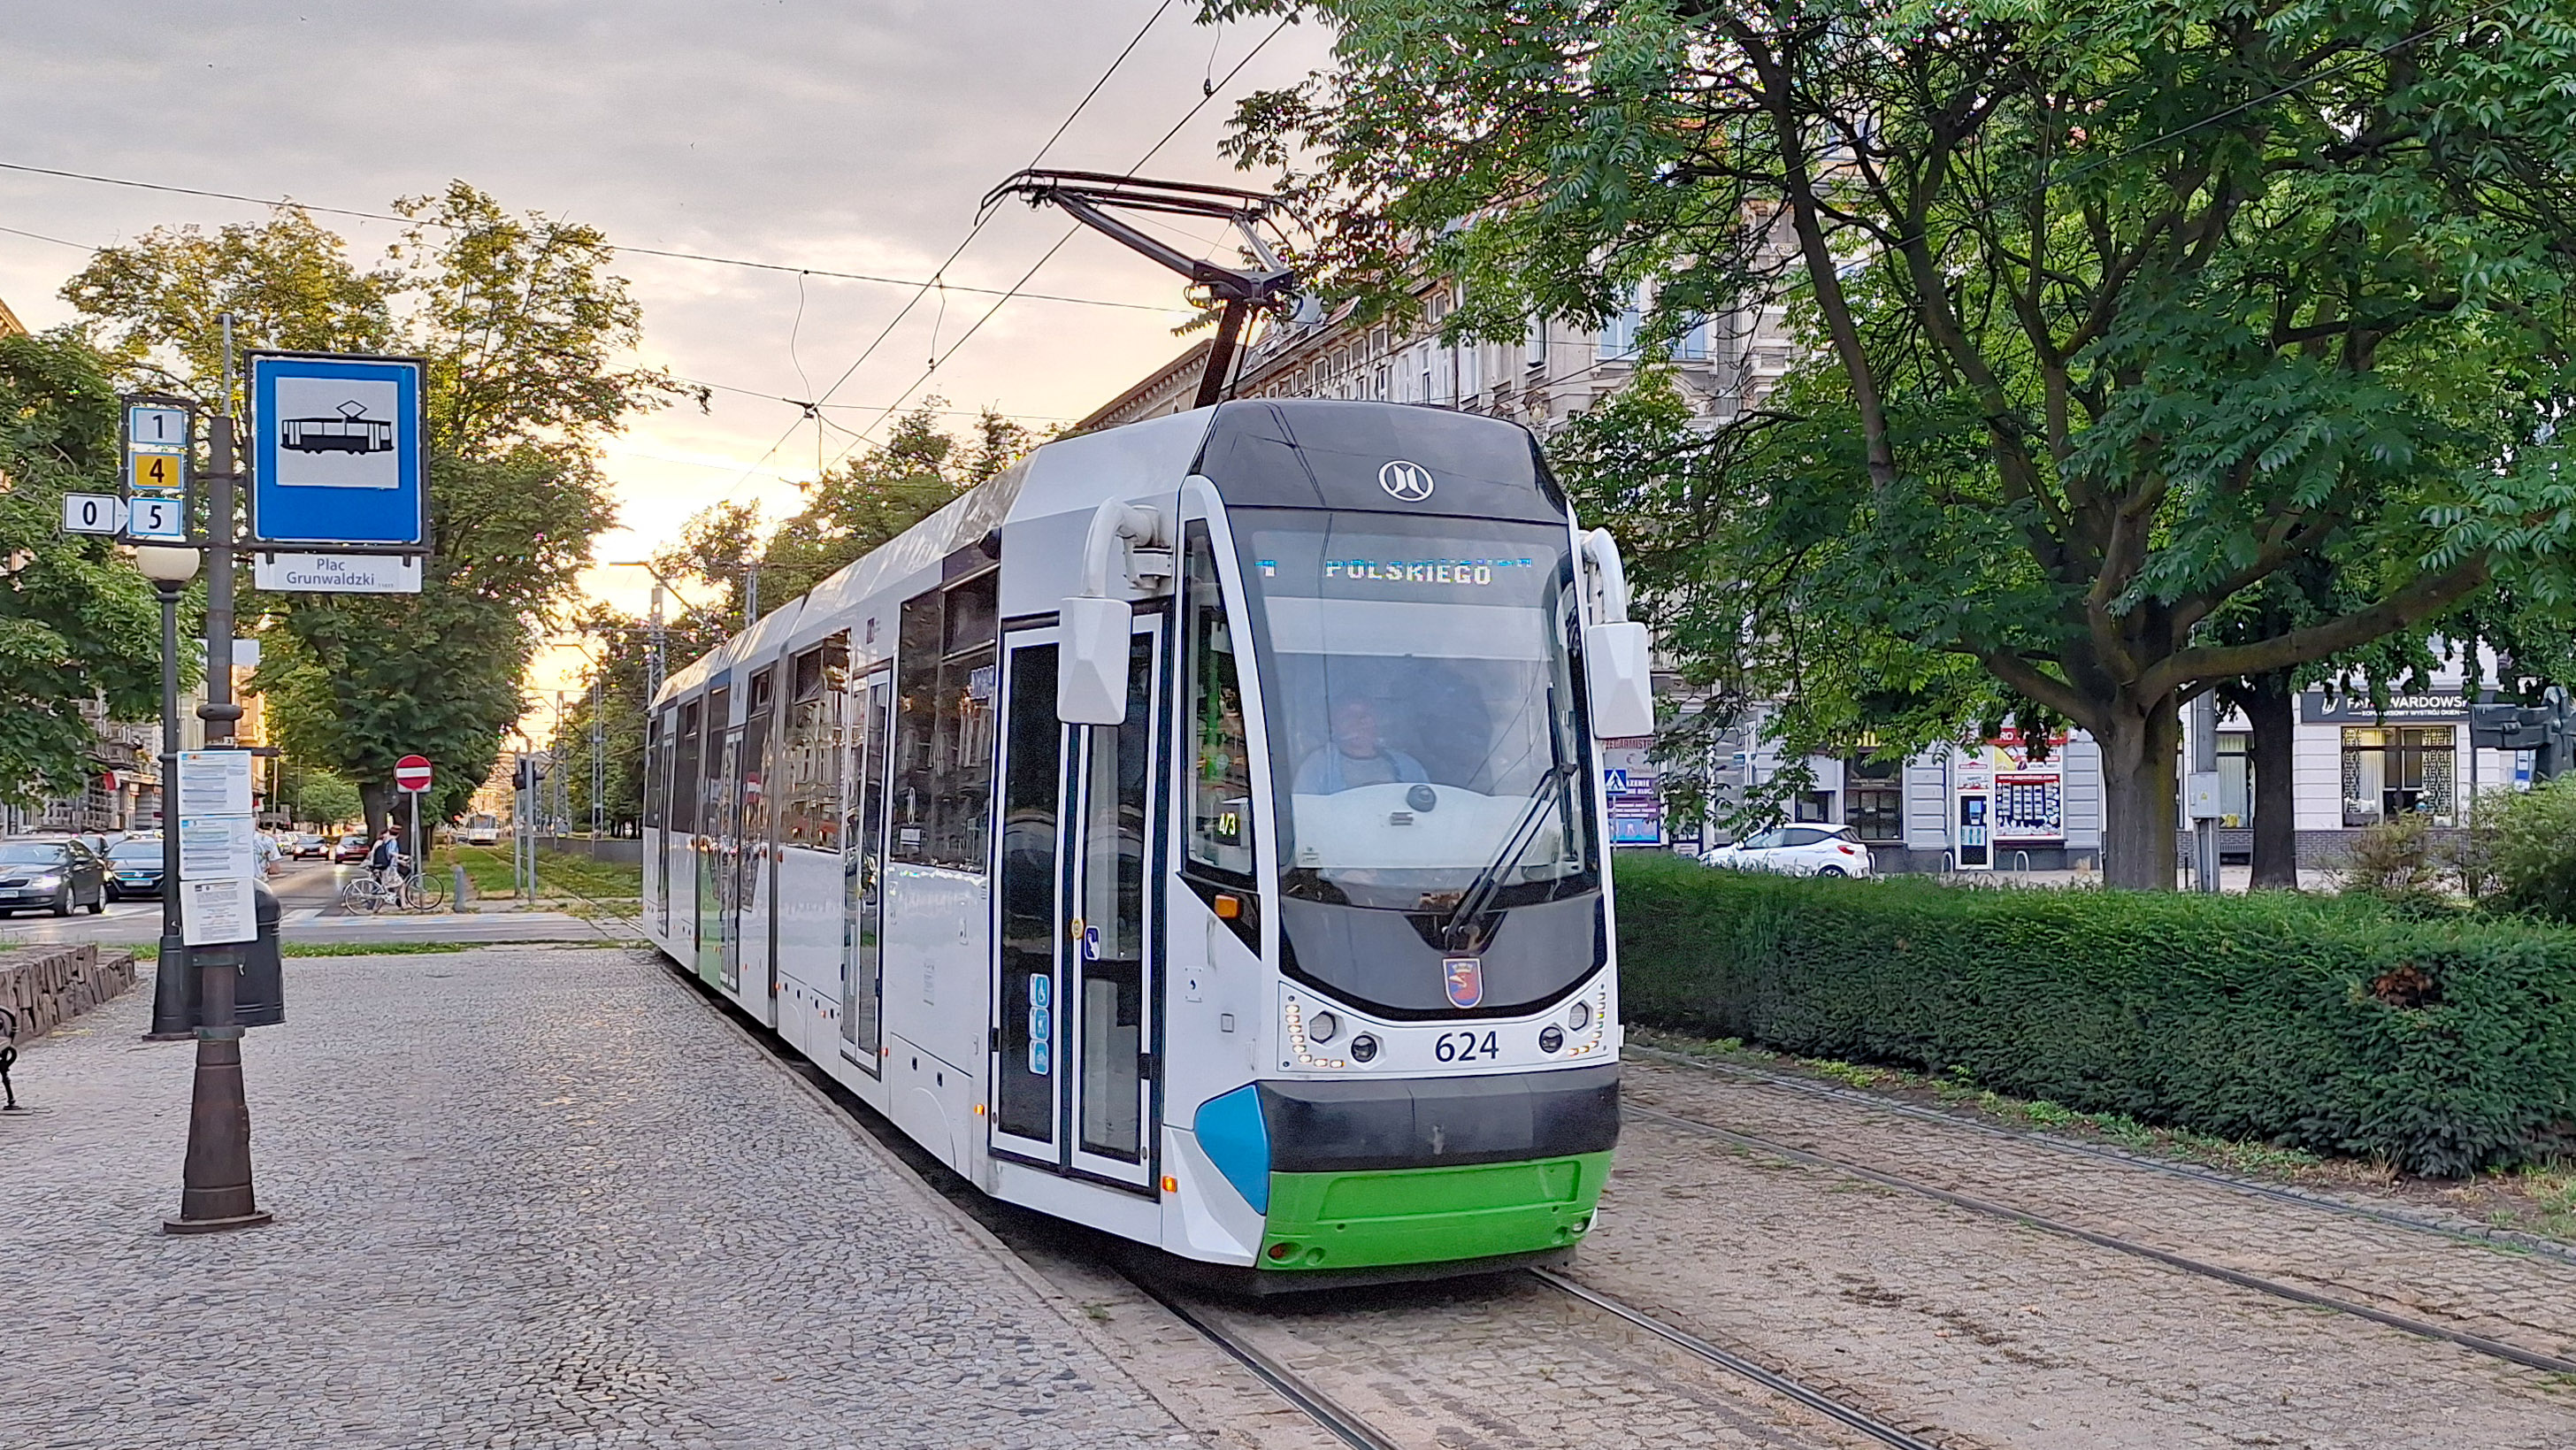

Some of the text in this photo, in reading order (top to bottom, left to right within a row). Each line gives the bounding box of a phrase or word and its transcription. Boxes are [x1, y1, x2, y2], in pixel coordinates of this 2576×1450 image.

[152, 414, 164, 439] 1
[150, 458, 165, 483] 4
[82, 501, 97, 526] 0
[149, 504, 162, 529] 5
[316, 558, 345, 571] Plac
[1325, 559, 1491, 586] POLSKIEGO
[286, 572, 375, 586] Grunwaldzki
[1435, 1031, 1499, 1062] 624
